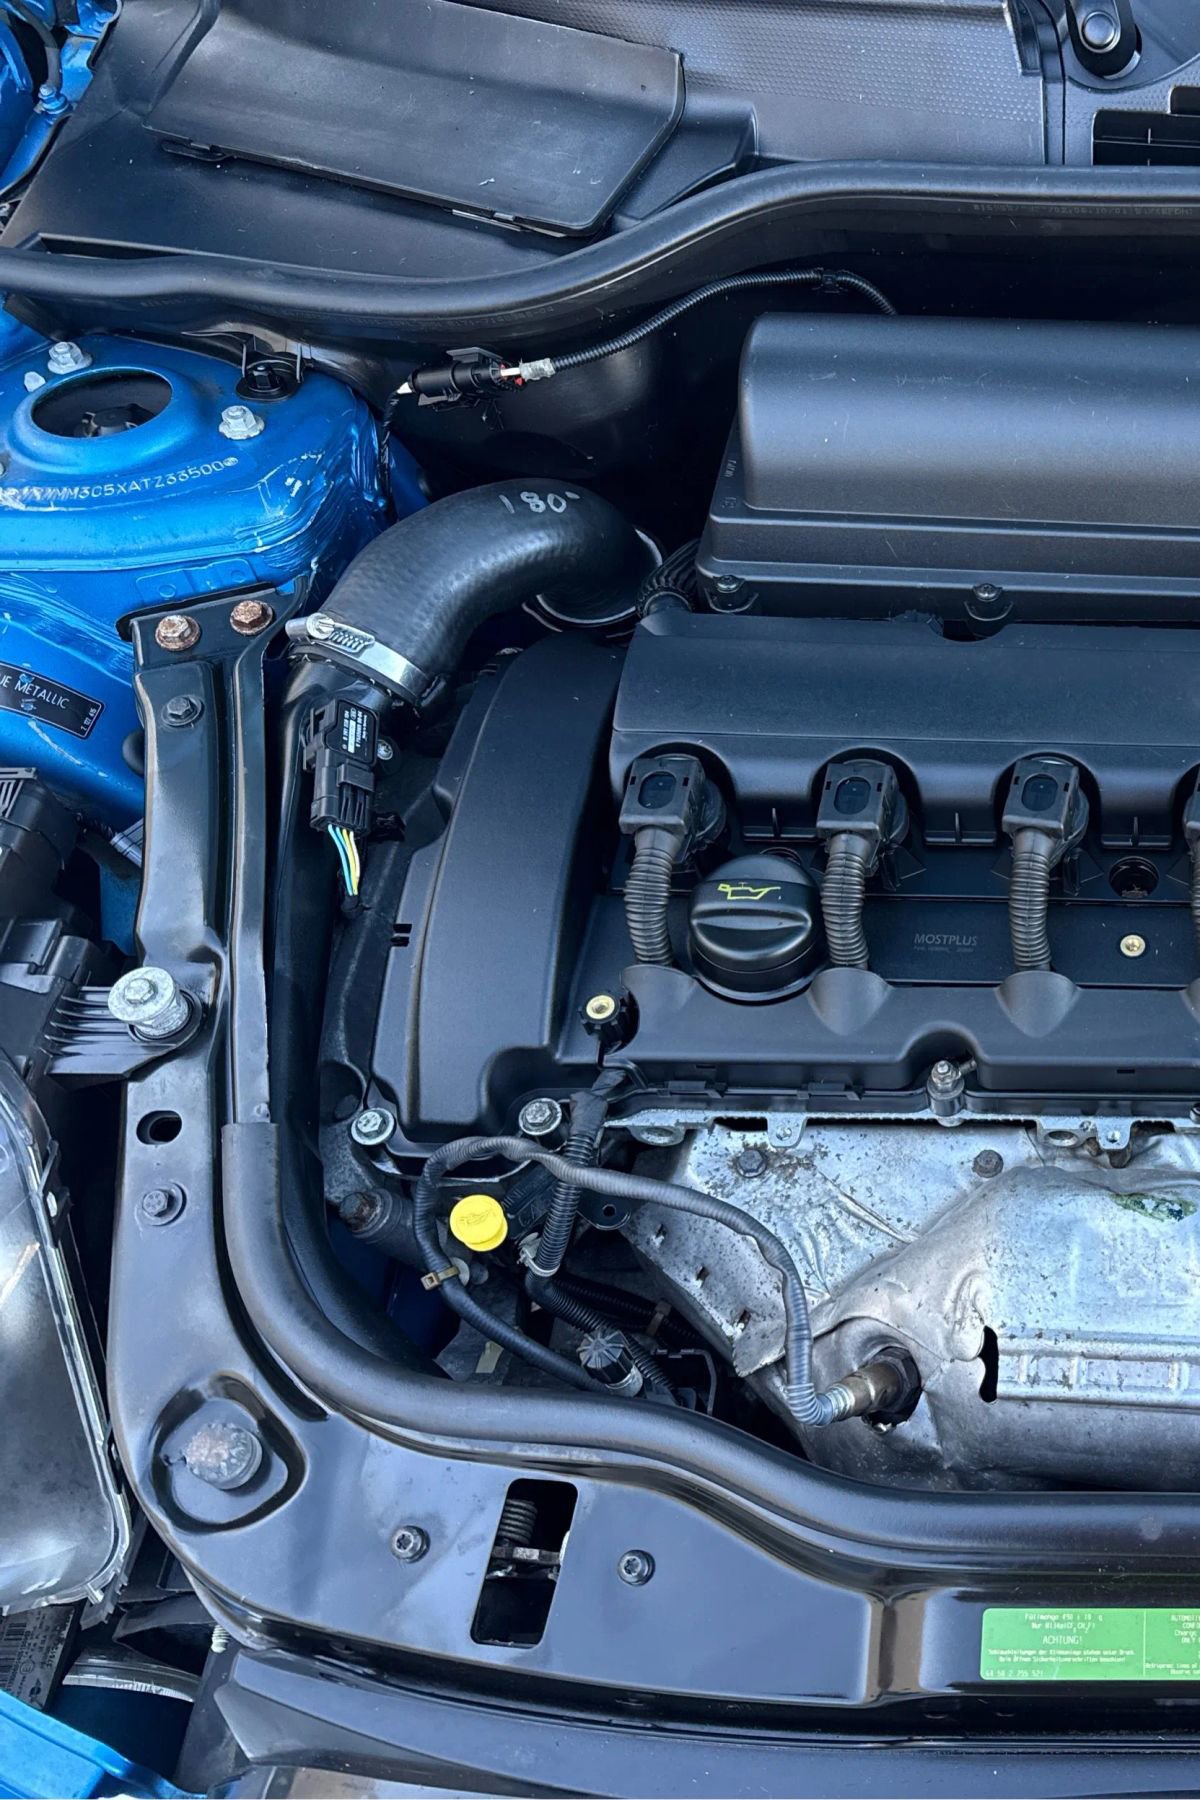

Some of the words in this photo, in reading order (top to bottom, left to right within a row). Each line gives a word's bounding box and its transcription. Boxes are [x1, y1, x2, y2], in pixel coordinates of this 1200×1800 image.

[14, 679, 70, 709] METALLIC
[914, 933, 978, 946] MOSTPLUS
[1042, 1635, 1082, 1645] ACHTUNG!
